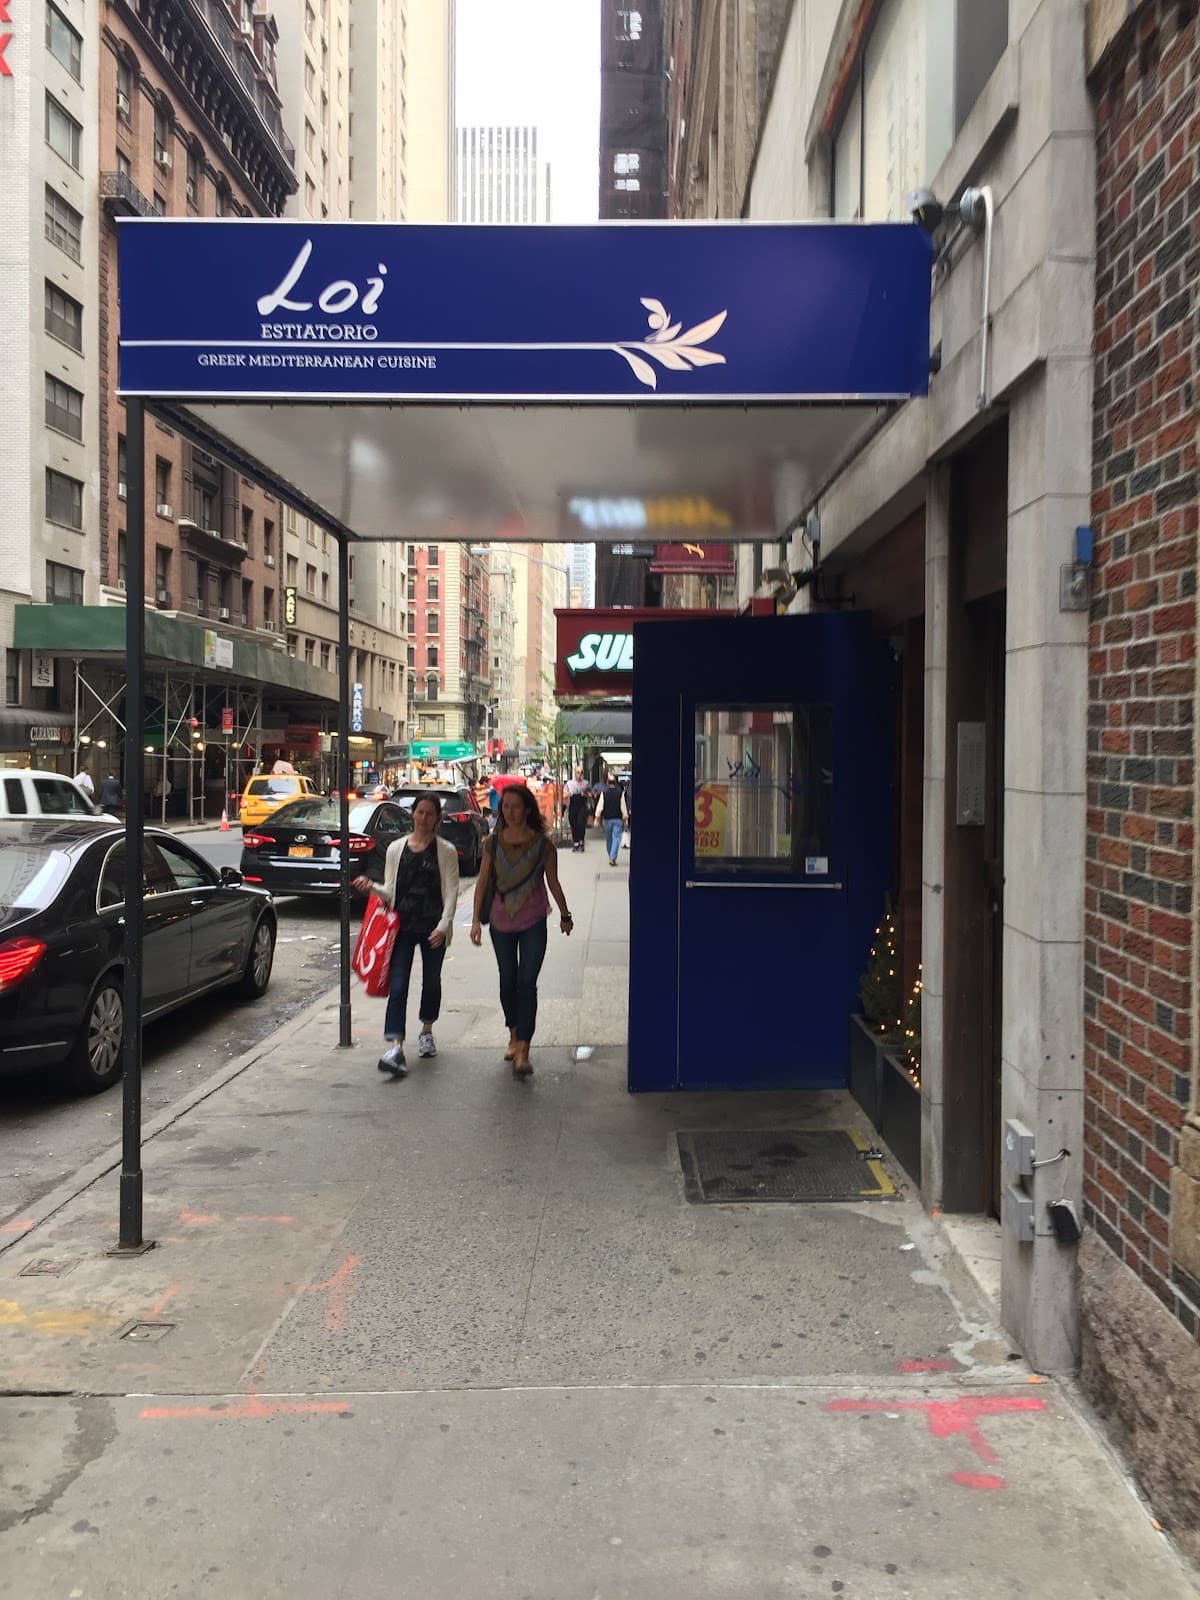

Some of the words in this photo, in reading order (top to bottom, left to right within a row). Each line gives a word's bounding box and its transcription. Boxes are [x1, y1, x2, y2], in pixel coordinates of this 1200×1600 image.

[256, 238, 388, 316] Loi
[260, 323, 378, 340] ESTIATORIO
[197, 354, 246, 367] GREEK
[249, 355, 374, 369] MEDITERRANEAN
[377, 356, 437, 370] CUISINE
[30, 726, 61, 741] CLEANERS
